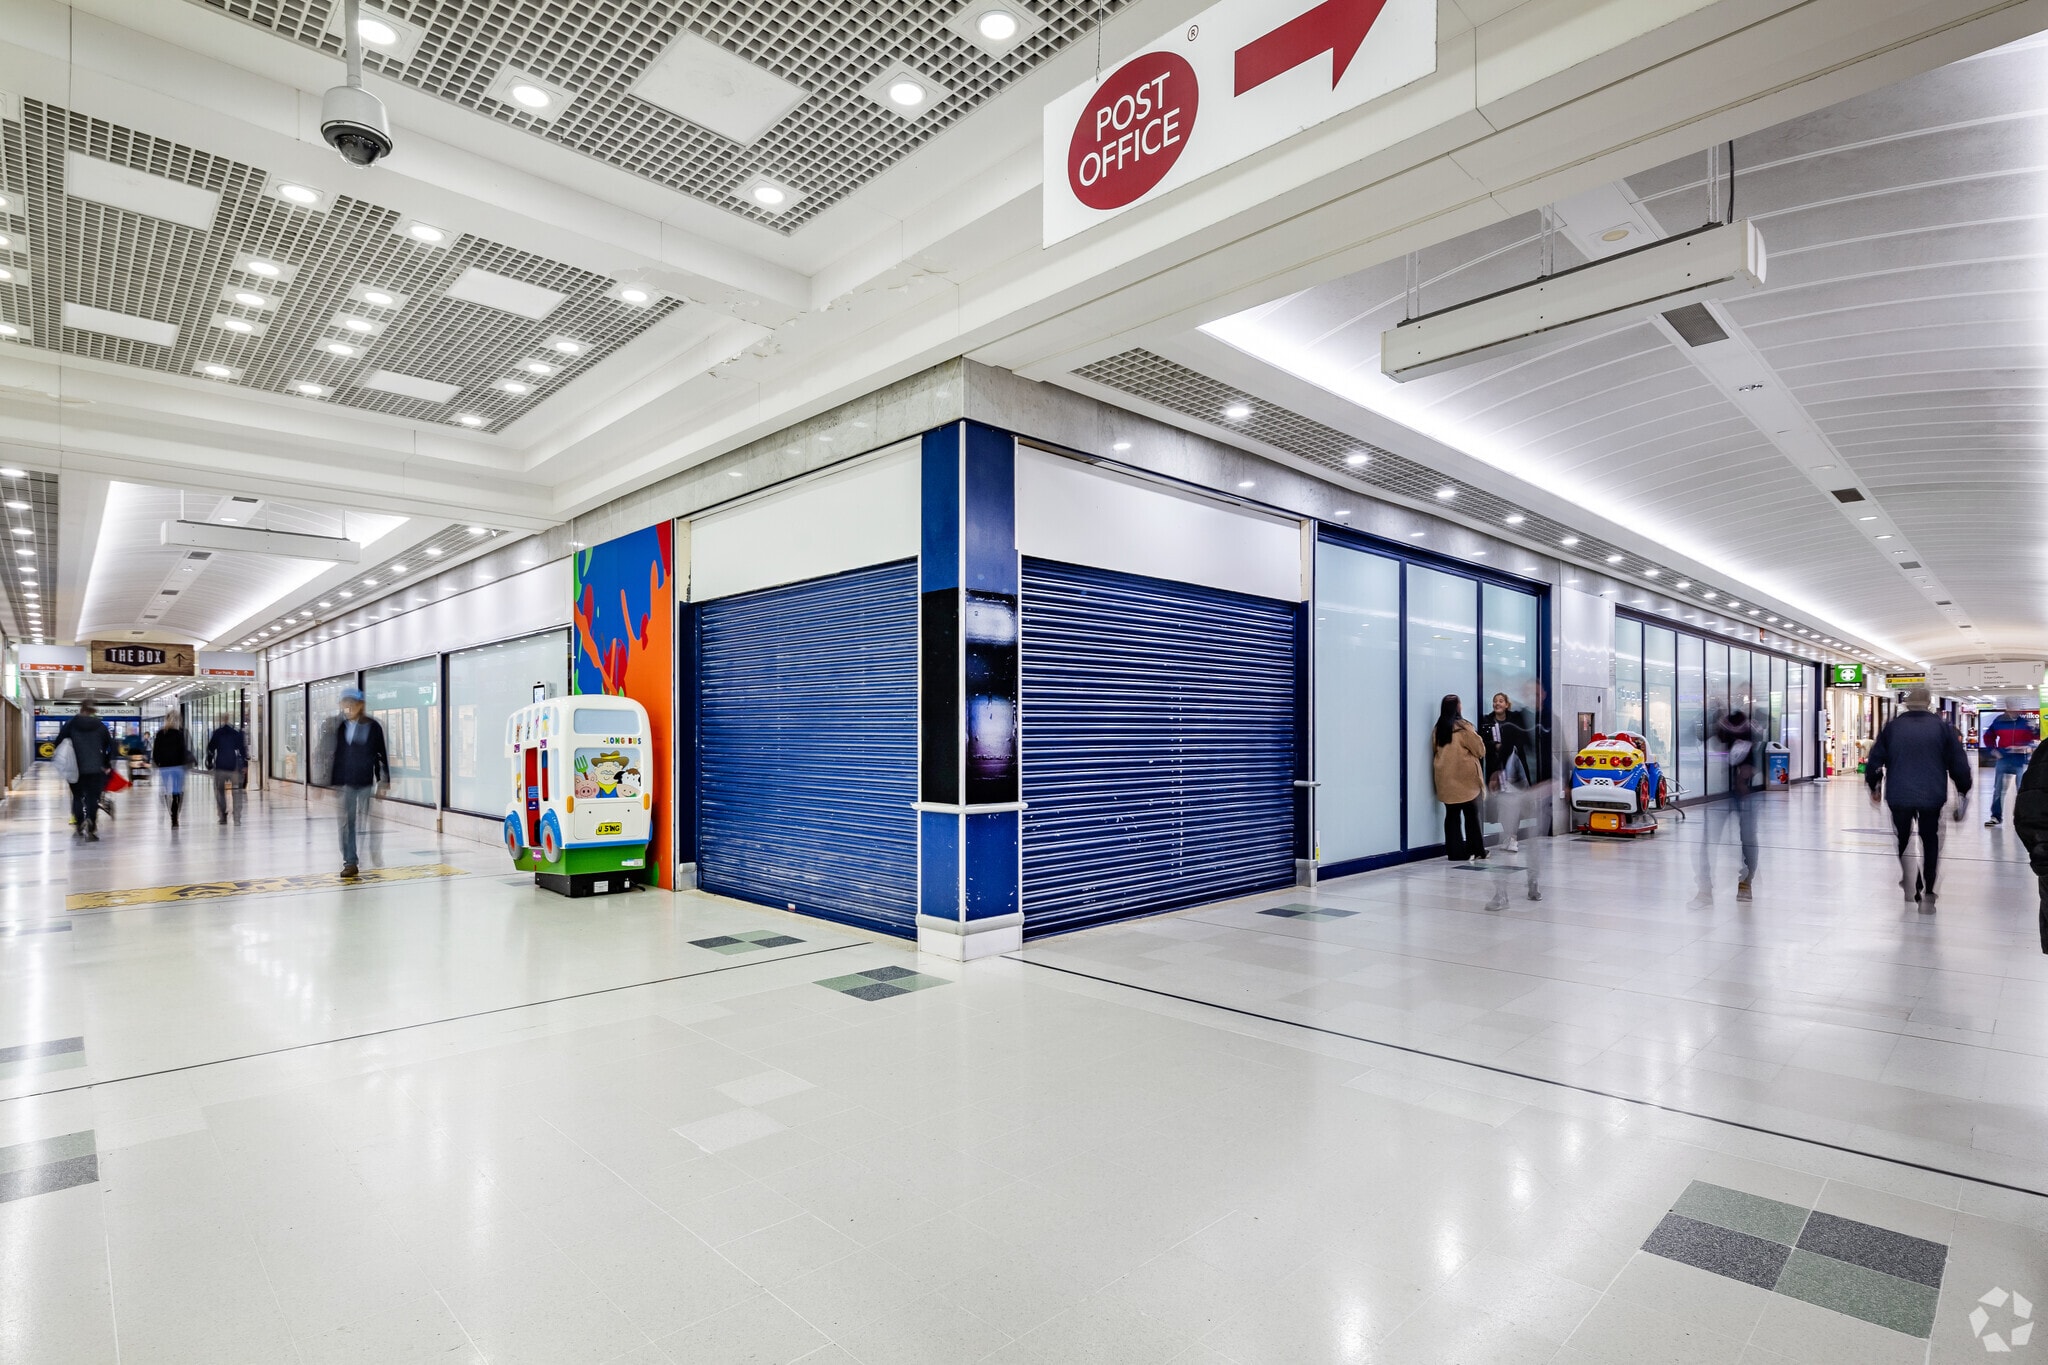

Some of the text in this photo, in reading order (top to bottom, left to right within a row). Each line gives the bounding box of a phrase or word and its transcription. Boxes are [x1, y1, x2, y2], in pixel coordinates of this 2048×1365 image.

[1096, 71, 1171, 142] POST
[1078, 107, 1181, 187] OFFICE
[110, 649, 161, 663] THE BOX
[628, 737, 642, 745] BUS
